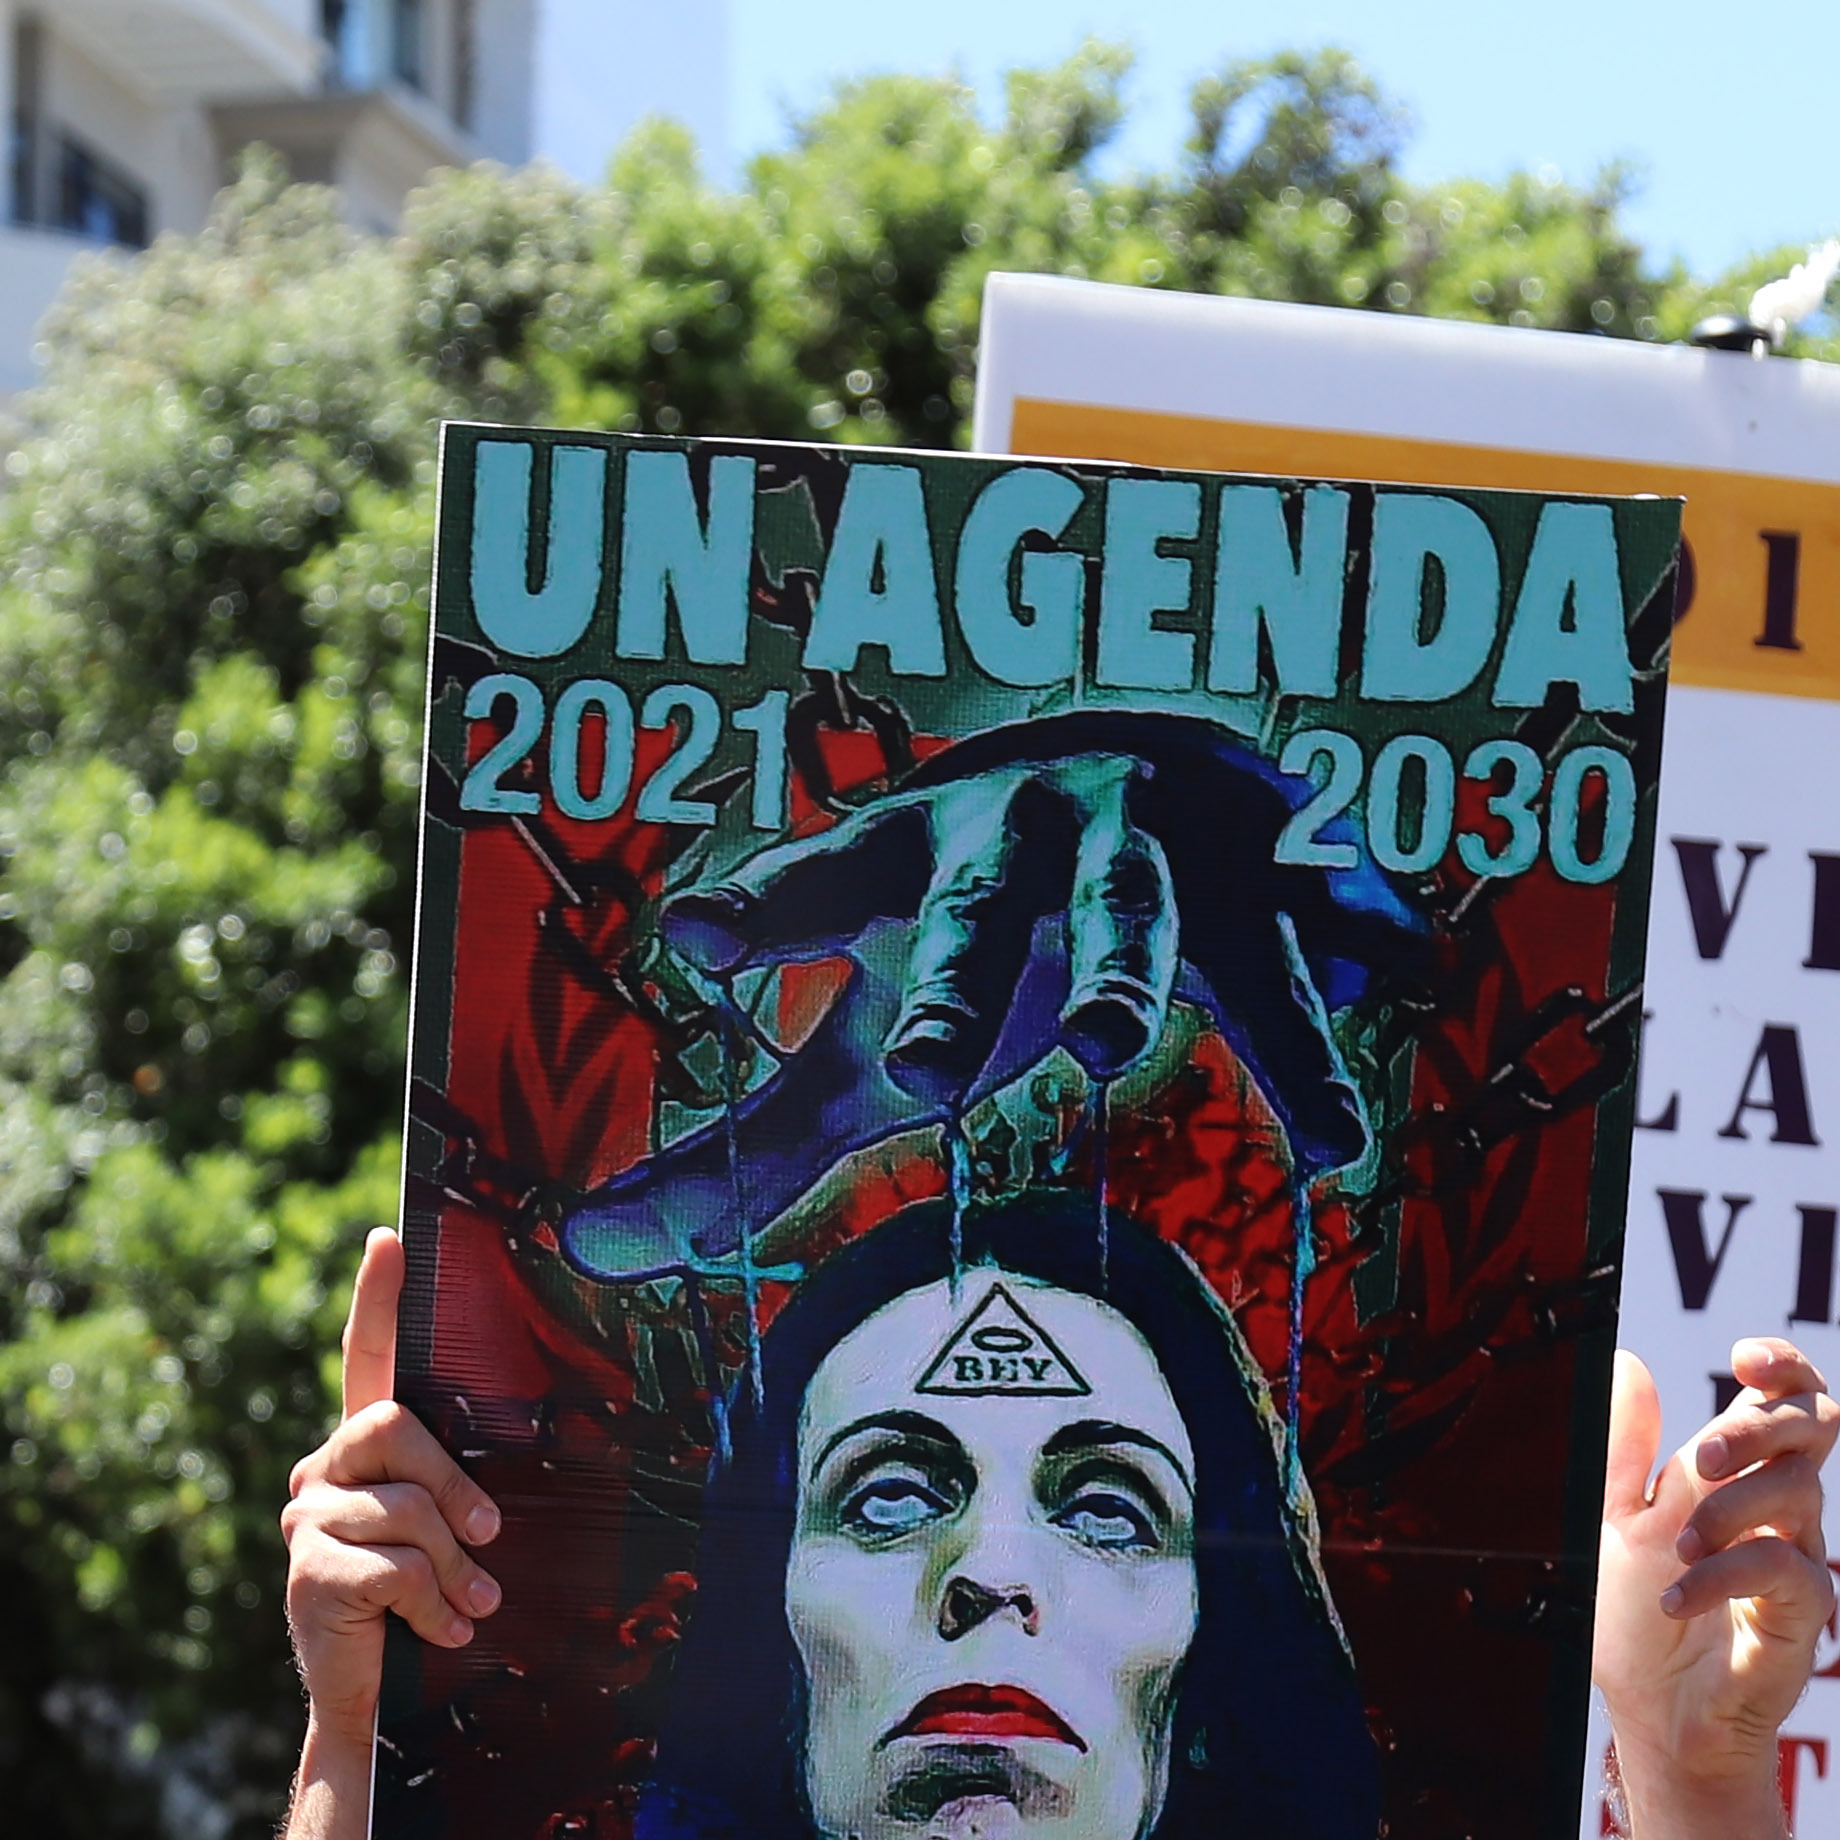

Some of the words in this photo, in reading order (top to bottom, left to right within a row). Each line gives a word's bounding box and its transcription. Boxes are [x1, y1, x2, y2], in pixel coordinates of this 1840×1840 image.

[470, 440, 755, 666] UN
[802, 463, 1638, 716] AGENDA
[459, 673, 789, 830] 2021
[1274, 729, 1638, 884] 2030
